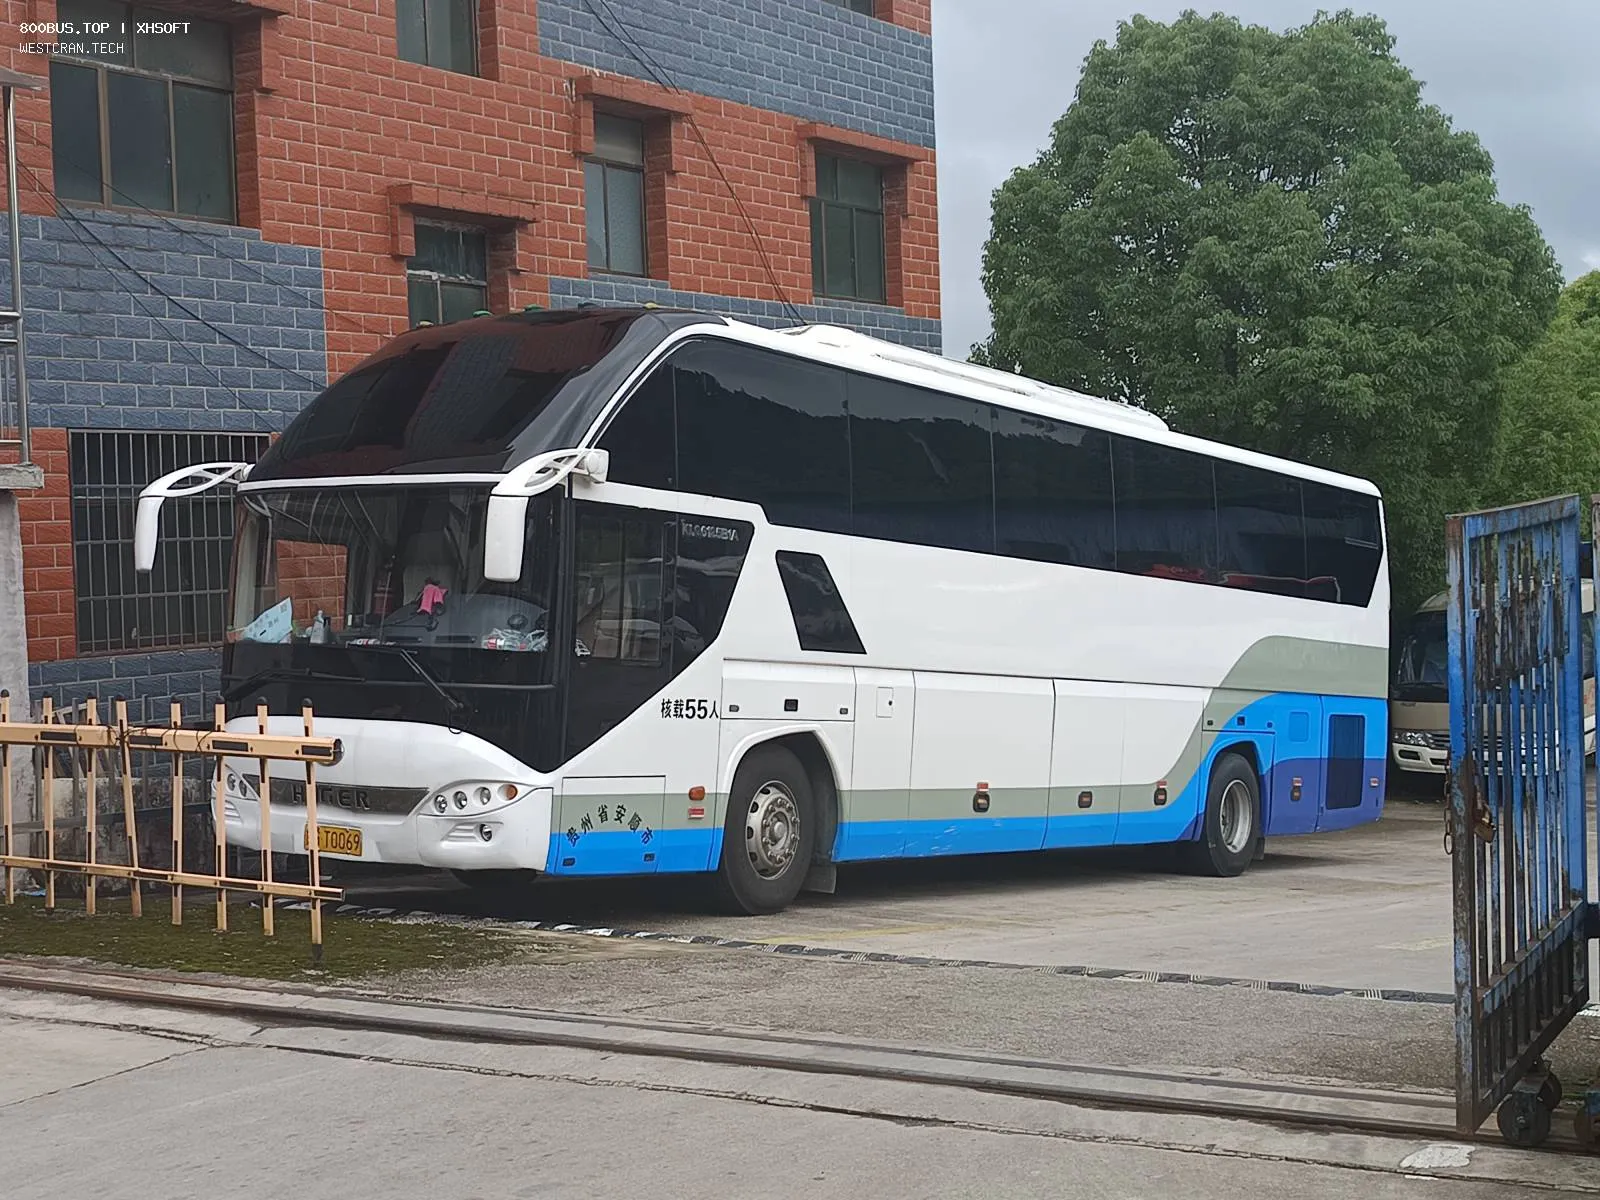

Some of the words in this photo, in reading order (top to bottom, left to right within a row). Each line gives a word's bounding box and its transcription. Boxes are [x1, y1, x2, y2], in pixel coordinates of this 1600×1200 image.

[661, 698, 719, 719] 核载55人
[291, 783, 370, 810] HGER
[566, 804, 654, 847] 贵州省安顺市
